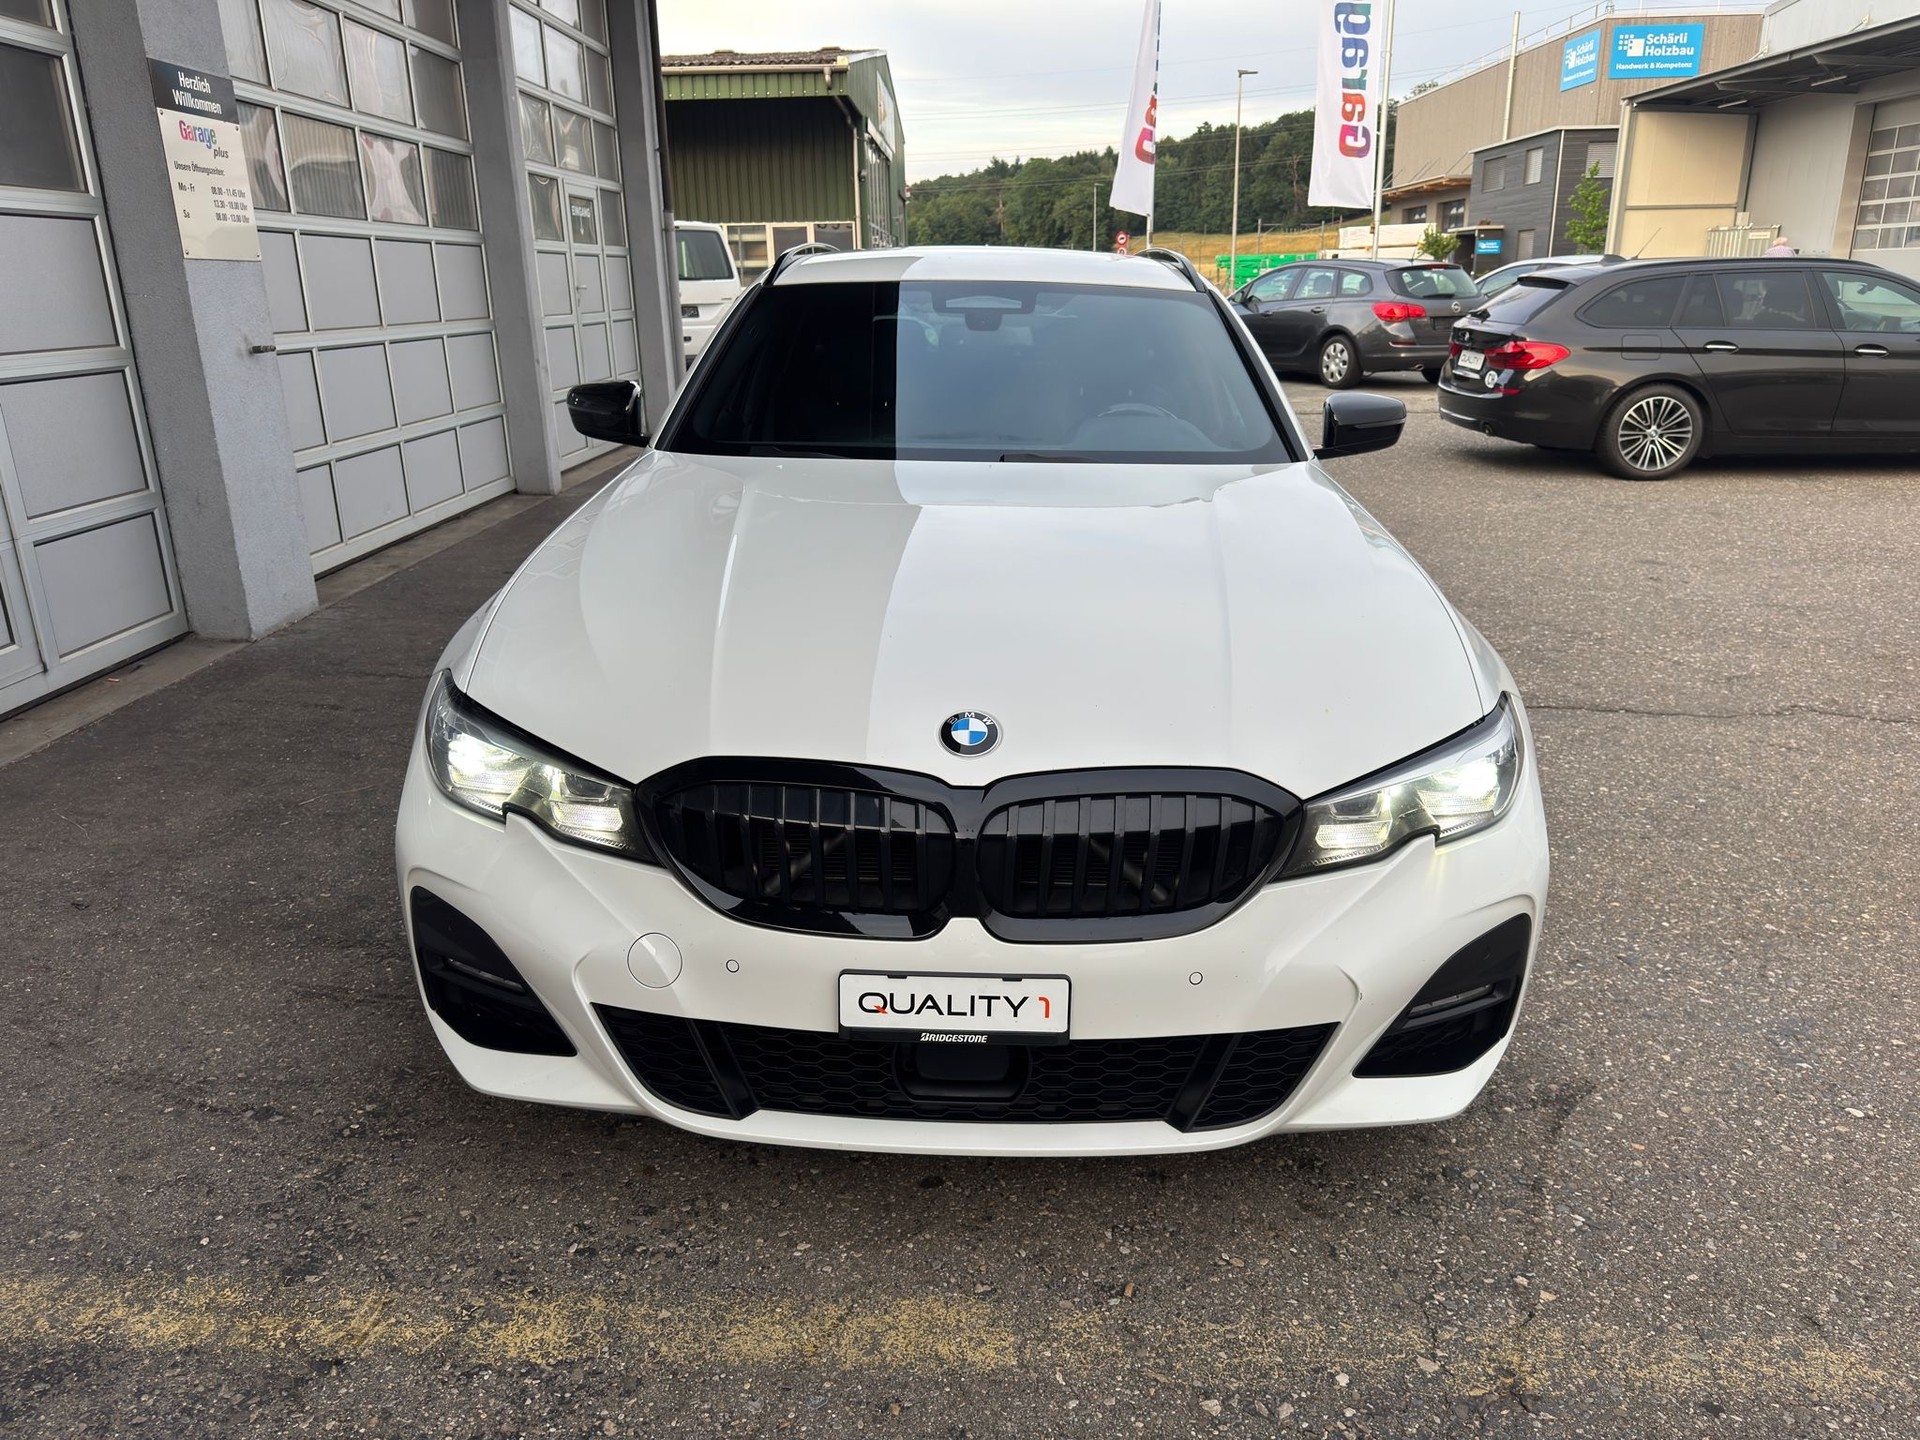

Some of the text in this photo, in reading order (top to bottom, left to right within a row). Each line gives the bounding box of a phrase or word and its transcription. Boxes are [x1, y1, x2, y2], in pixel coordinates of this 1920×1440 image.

[1646, 32, 1688, 45] Schärli
[1645, 45, 1695, 56] Holzbau
[1616, 62, 1649, 70] Handwerk
[1655, 61, 1693, 70] Kompetenz
[177, 71, 211, 93] Herzlich
[1334, 0, 1371, 158] Garag
[172, 89, 222, 114] Willkommen
[179, 120, 217, 149] Garage
[213, 147, 229, 159] plus
[947, 712, 994, 726] BMW
[858, 991, 1050, 1018] QUALITY 1
[920, 1032, 988, 1043] BRIDGESTONE
